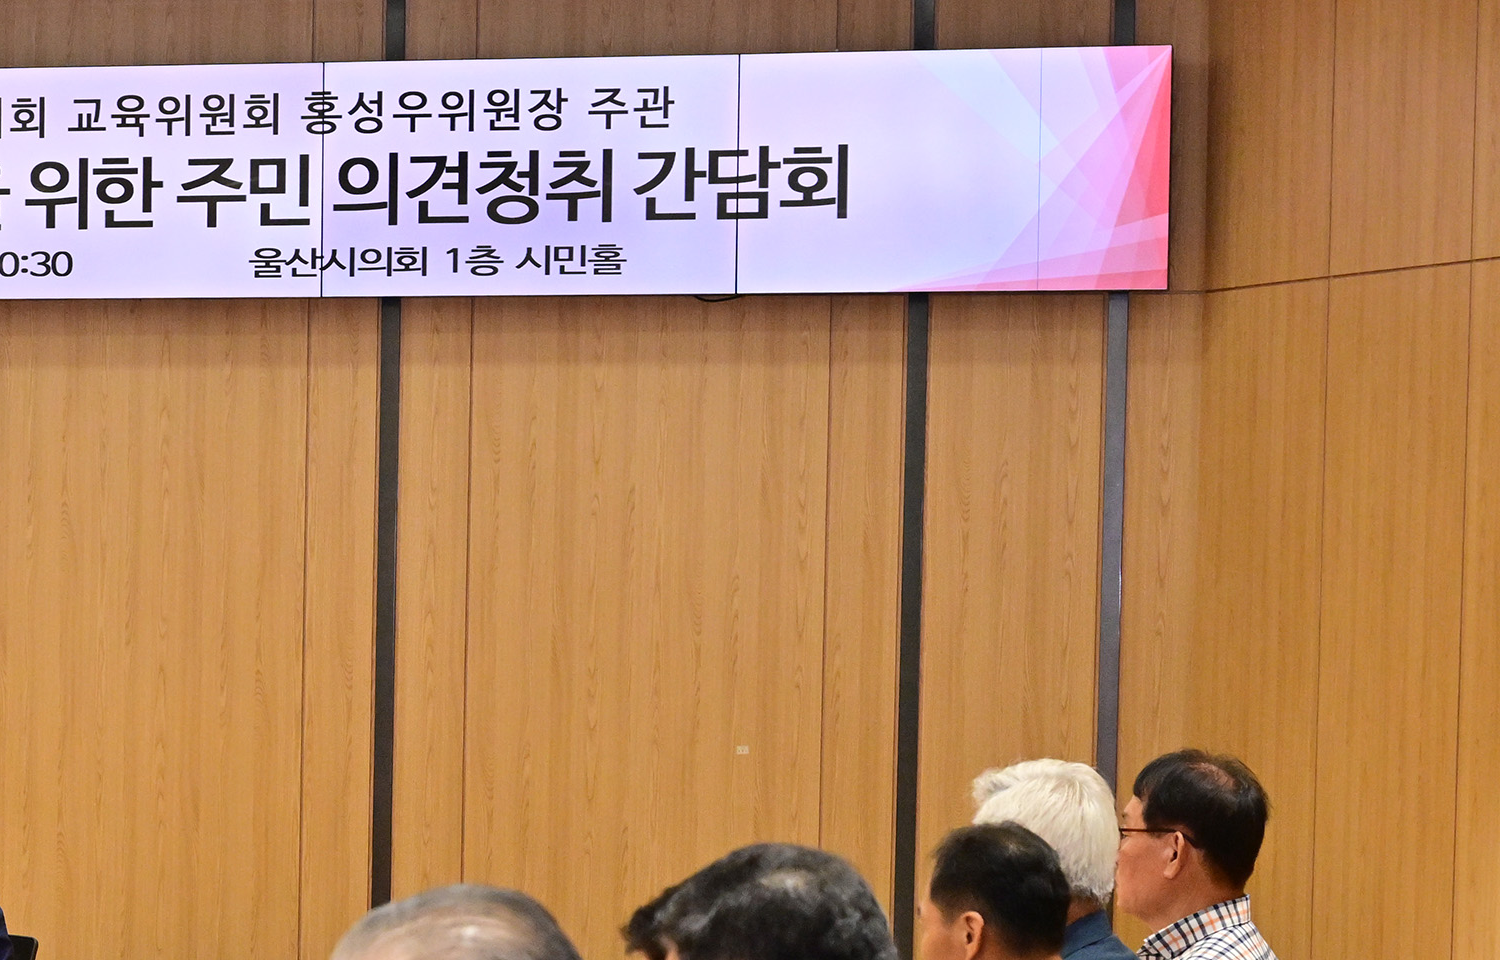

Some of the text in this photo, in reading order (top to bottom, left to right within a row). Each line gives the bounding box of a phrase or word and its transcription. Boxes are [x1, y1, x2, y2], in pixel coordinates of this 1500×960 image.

[67, 93, 279, 138] 교육위원회
[300, 88, 569, 134] 홍성우위원장
[587, 85, 675, 129] 주관
[25, 156, 164, 230] 위한
[176, 154, 311, 228] 주민
[332, 149, 613, 226] 의견청취
[632, 143, 849, 221] 간담회
[248, 243, 628, 279] 울산시의회 1층 시민홀
